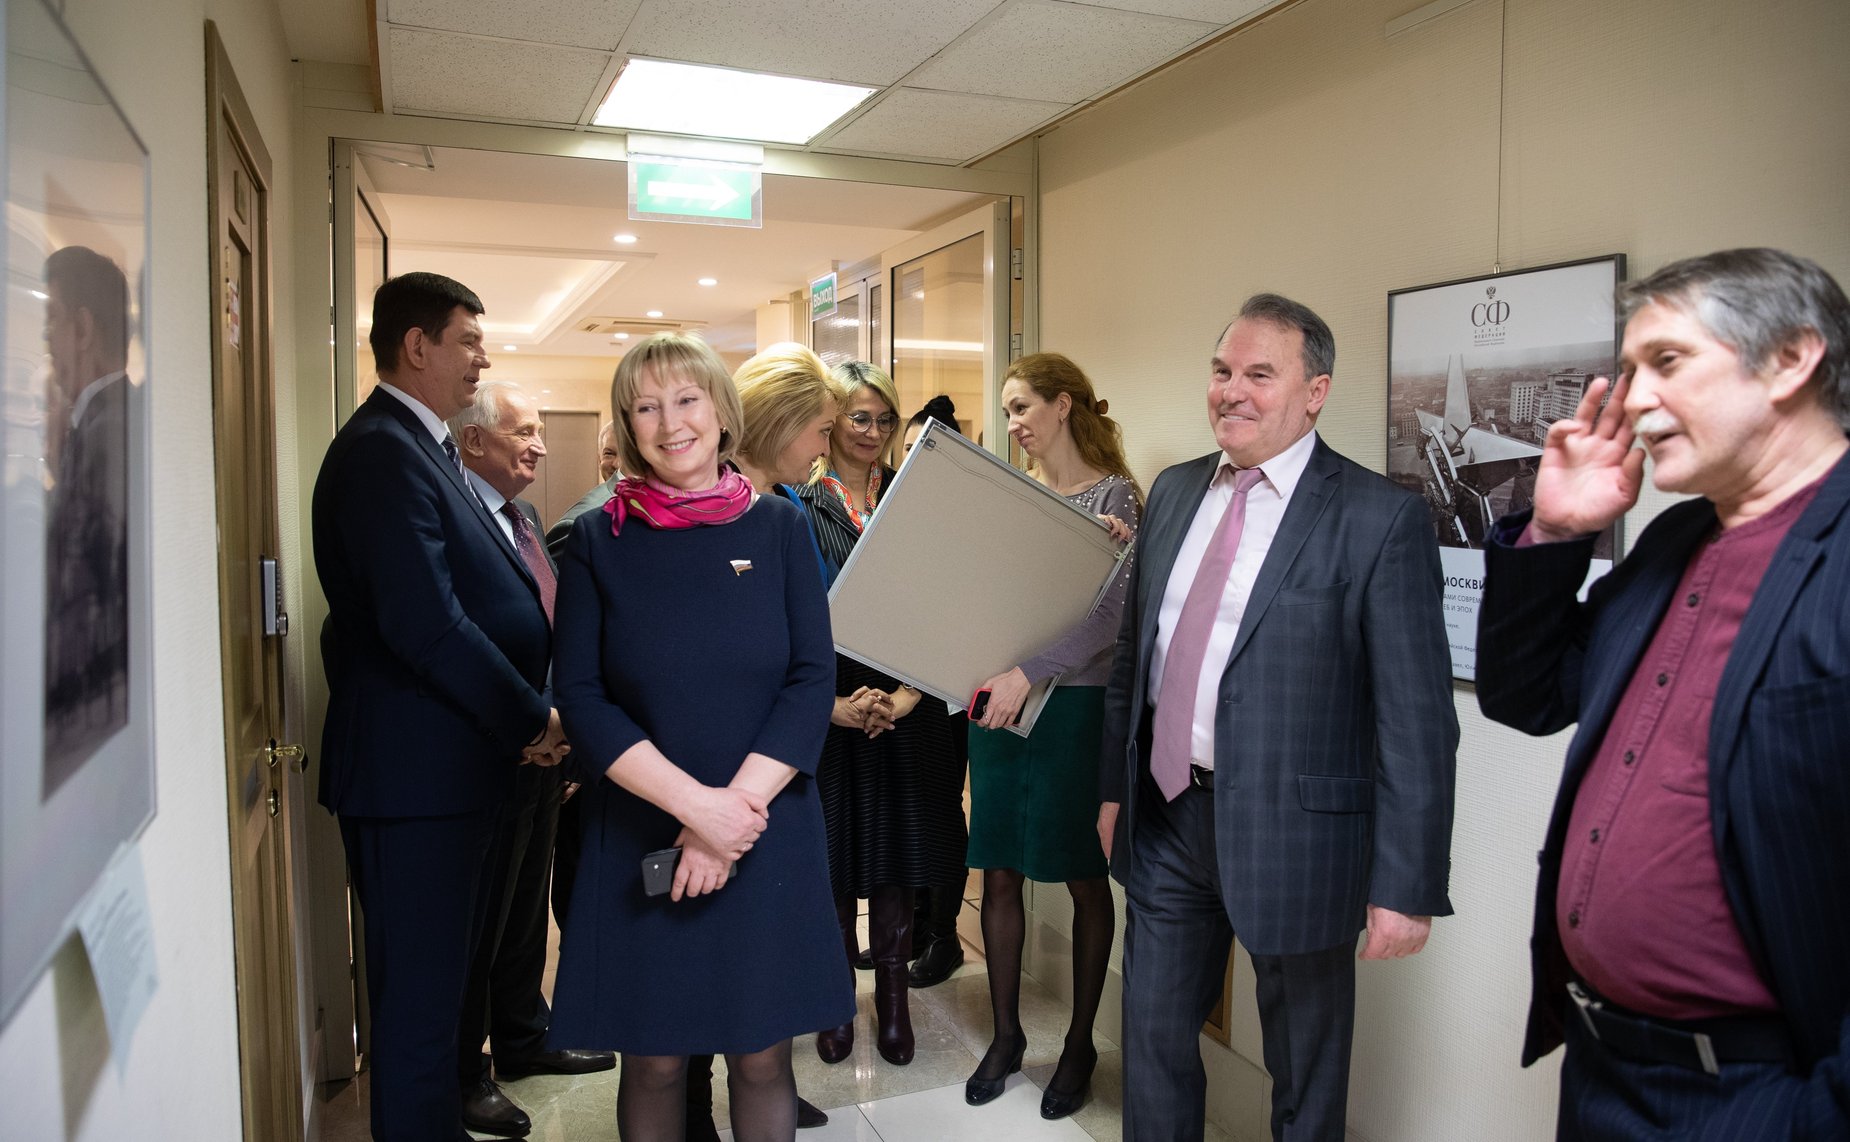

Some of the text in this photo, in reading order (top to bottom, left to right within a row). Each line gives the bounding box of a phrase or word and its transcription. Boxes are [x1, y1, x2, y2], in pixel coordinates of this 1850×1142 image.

[814, 287, 832, 308] ВЫХОД
[1471, 300, 1510, 327] СФ
[1457, 605, 1472, 614] ЭПОХ
